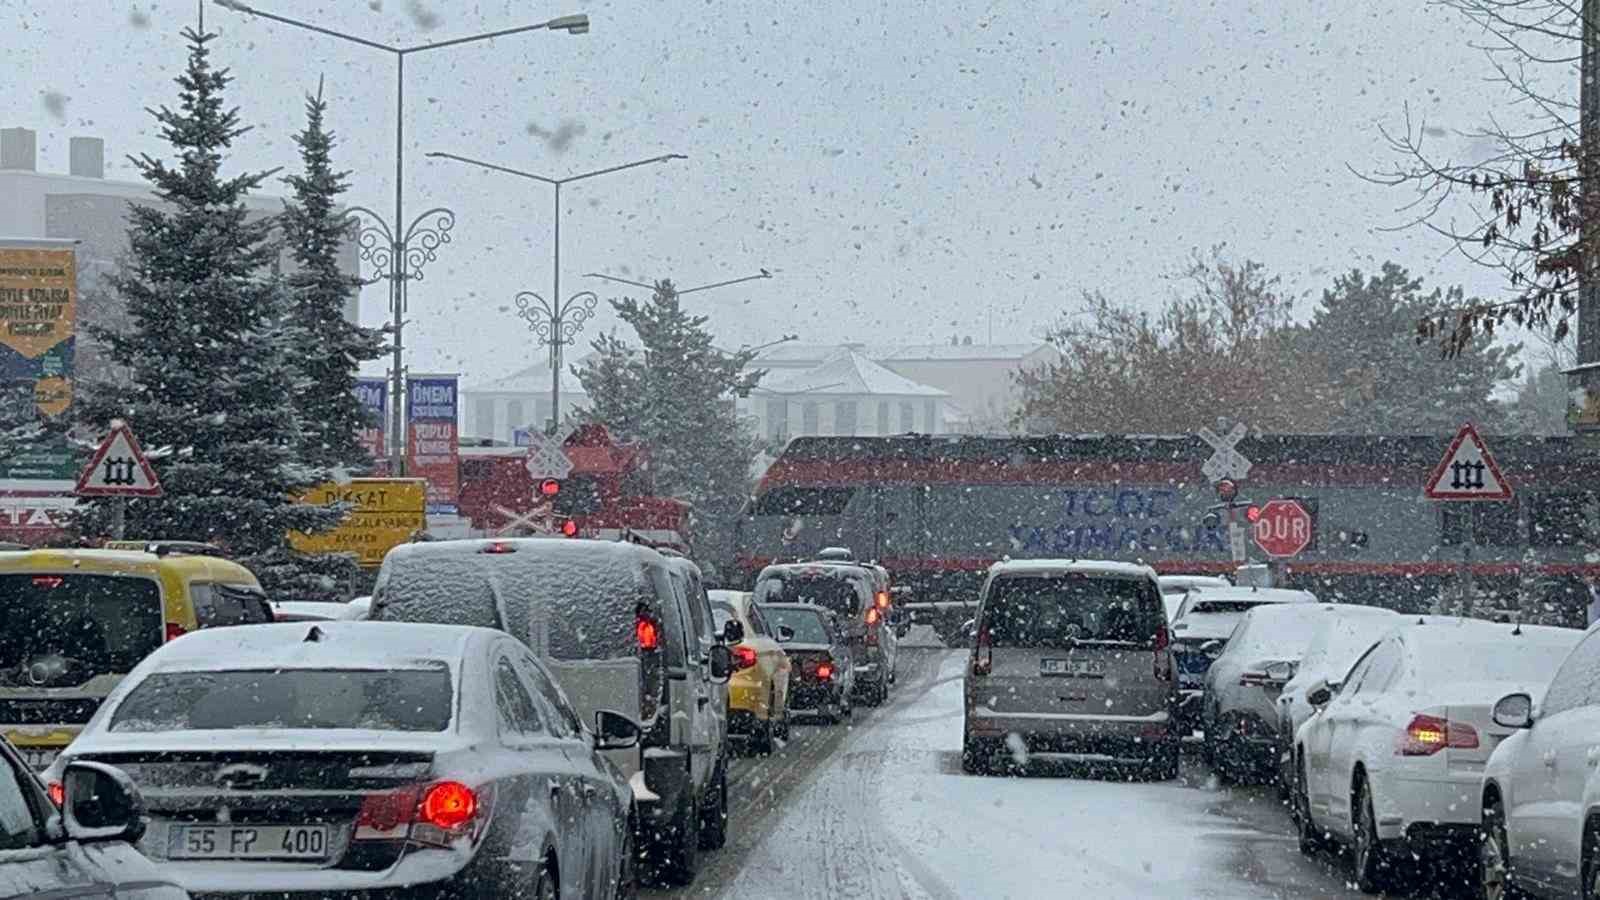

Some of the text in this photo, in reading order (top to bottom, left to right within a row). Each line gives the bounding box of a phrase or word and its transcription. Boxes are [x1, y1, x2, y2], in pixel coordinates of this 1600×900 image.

[412, 382, 453, 404] ÖNEM
[1258, 514, 1306, 540] DUR
[186, 829, 216, 854] 55
[281, 829, 324, 854] 400
